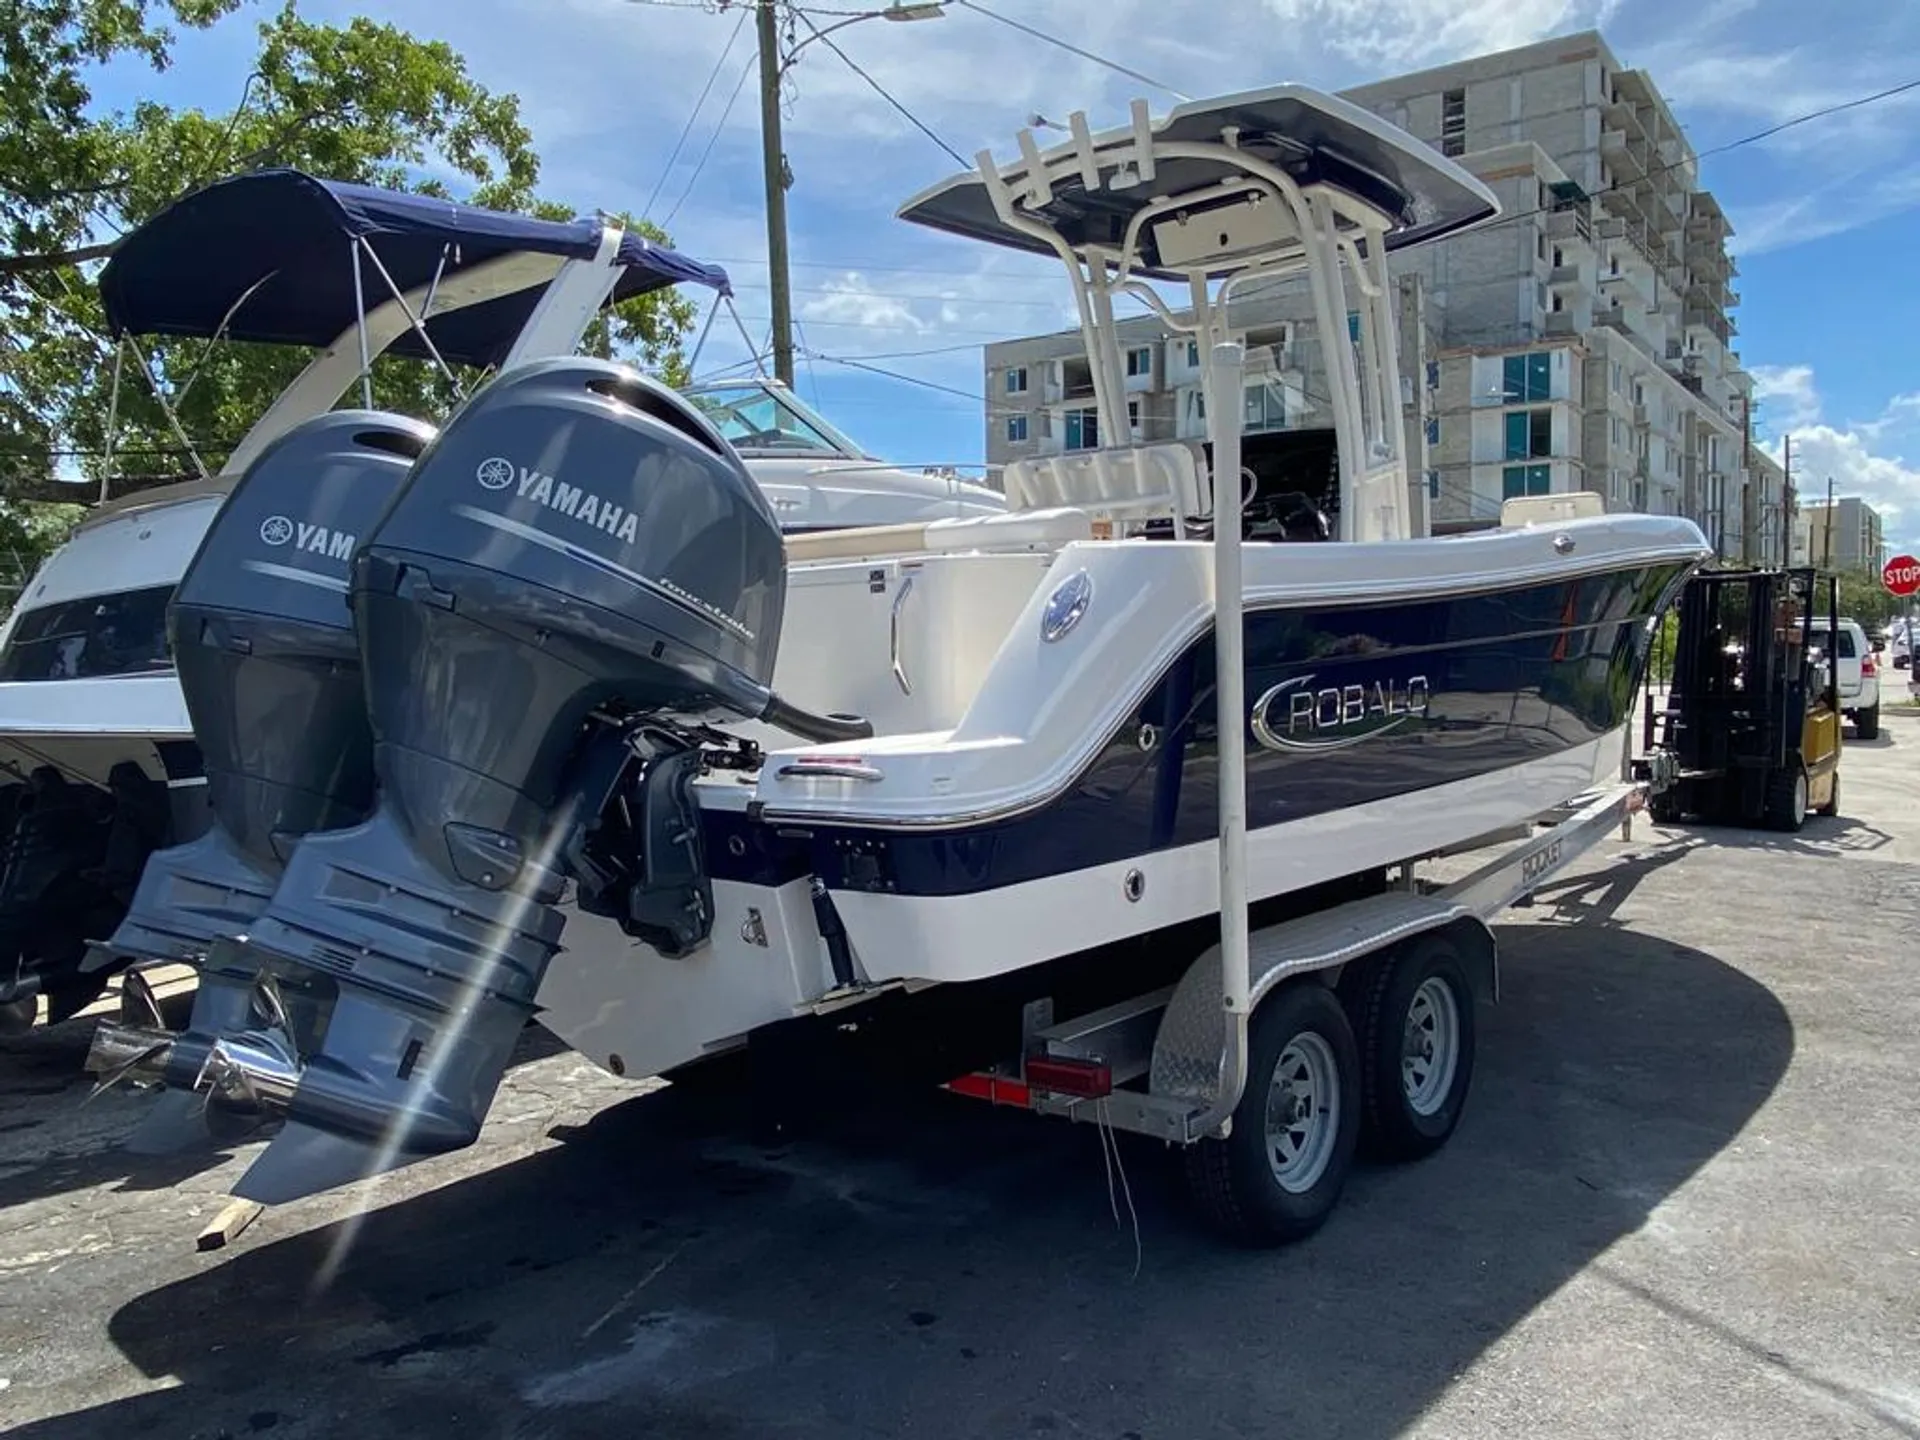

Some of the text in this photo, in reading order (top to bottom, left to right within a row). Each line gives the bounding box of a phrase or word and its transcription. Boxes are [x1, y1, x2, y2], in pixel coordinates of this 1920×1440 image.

[516, 467, 639, 545] YAMAHA
[296, 522, 356, 562] YAM
[1886, 566, 1920, 585] STOP
[1288, 674, 1429, 735] ROBALO
